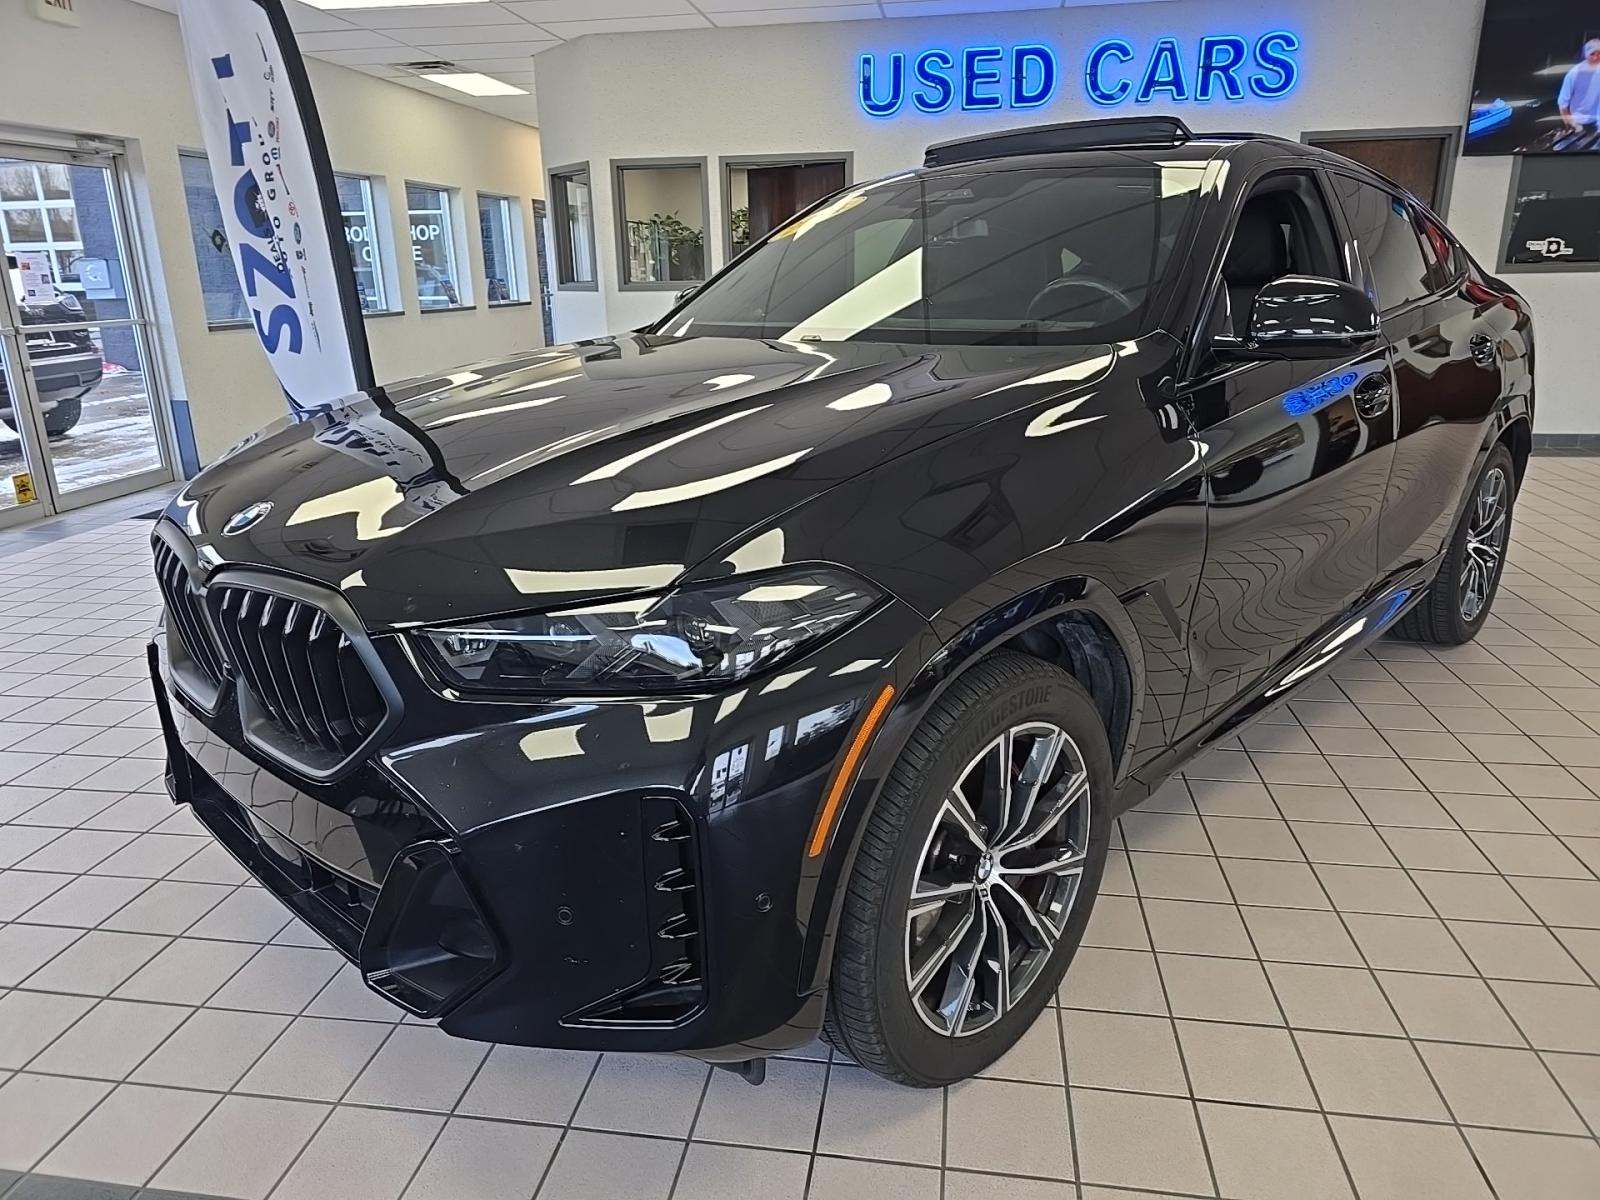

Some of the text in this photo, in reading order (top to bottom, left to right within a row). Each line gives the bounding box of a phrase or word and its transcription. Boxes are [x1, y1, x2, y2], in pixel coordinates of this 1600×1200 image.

[859, 31, 1298, 116] USED CARS
[211, 53, 303, 354] SZOT
[409, 224, 440, 242] HOP
